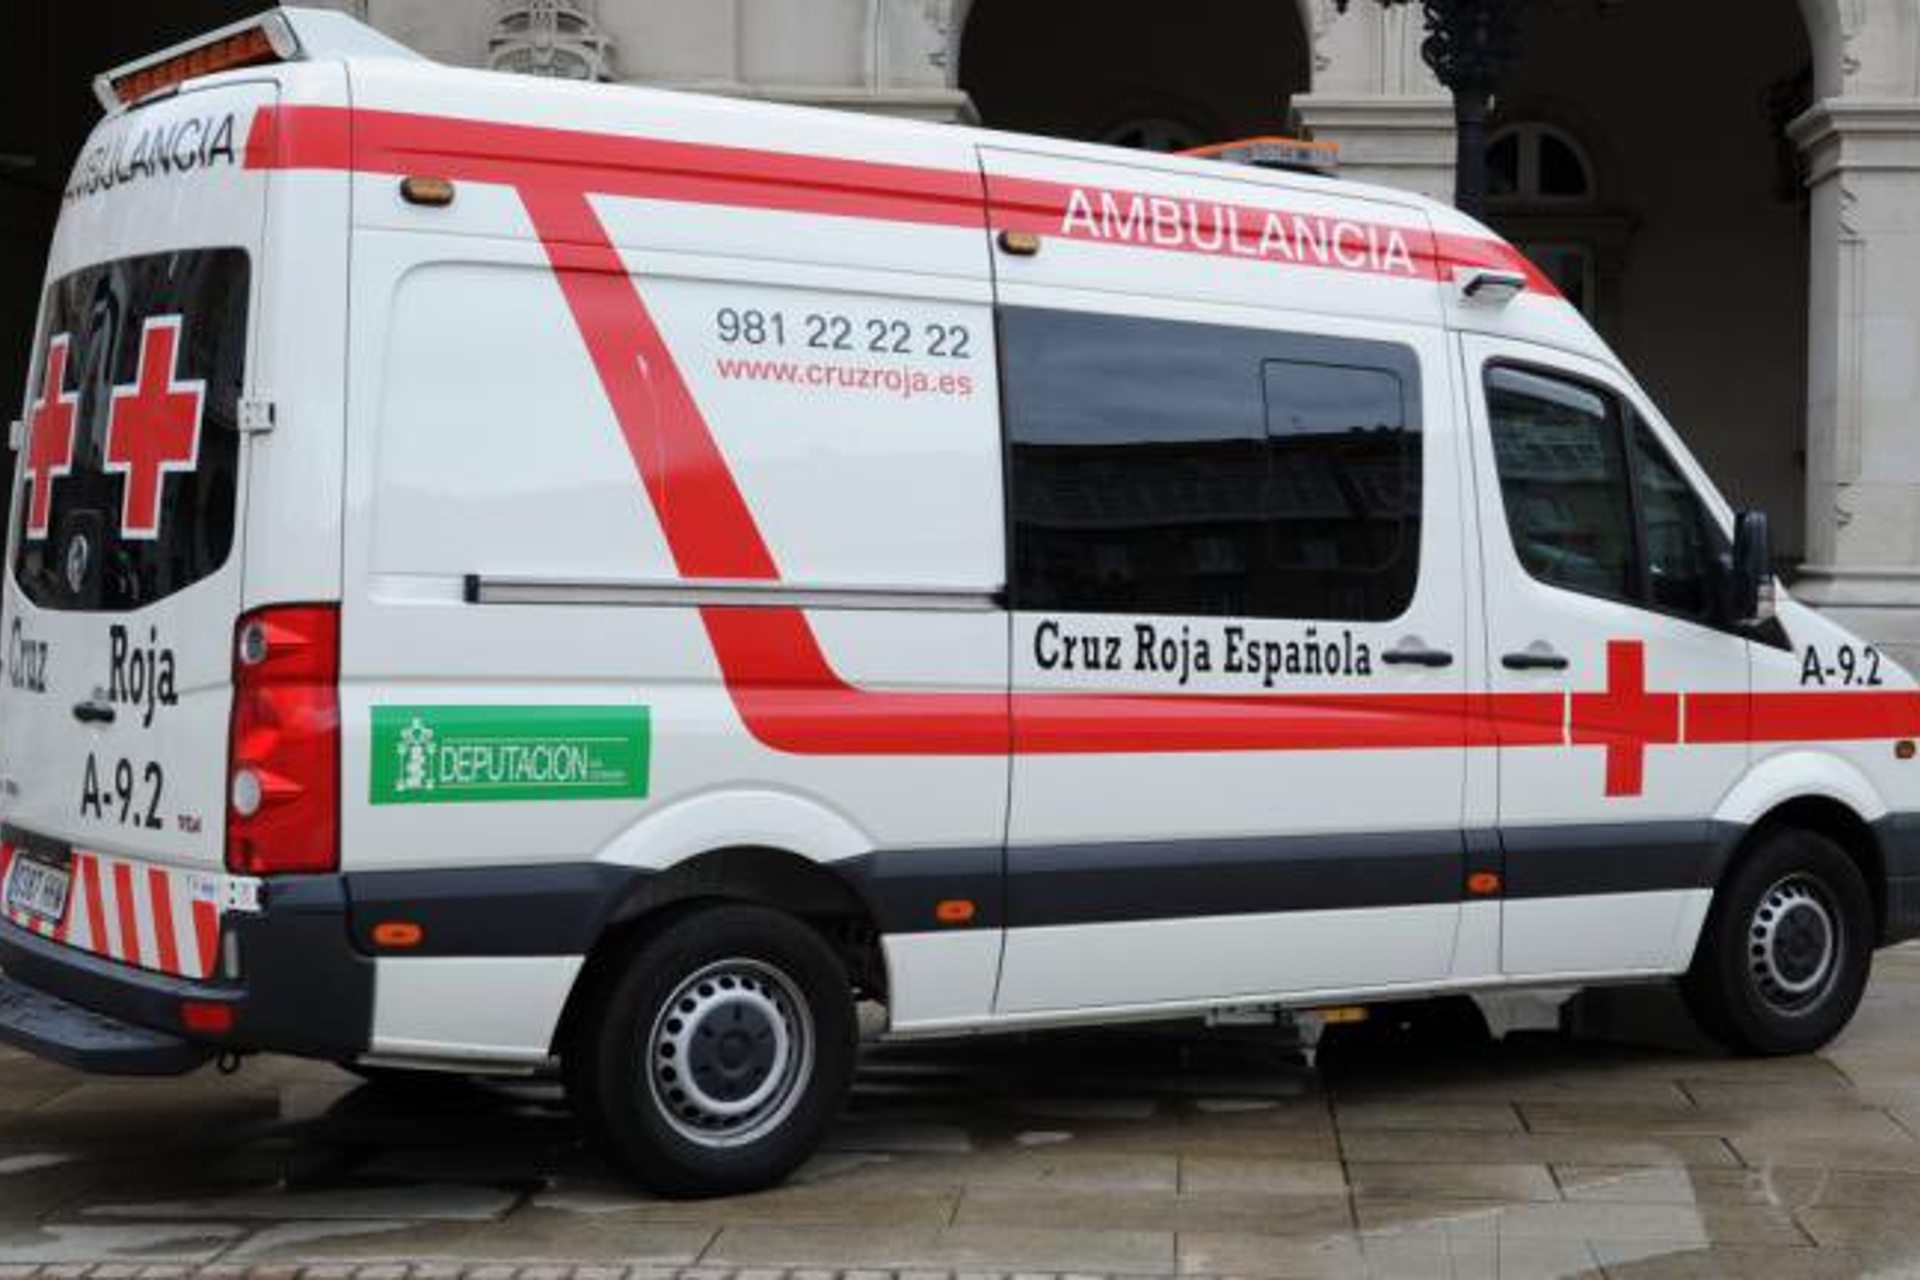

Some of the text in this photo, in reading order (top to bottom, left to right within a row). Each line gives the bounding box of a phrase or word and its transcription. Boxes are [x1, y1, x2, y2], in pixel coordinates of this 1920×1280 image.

[63, 113, 235, 206] BULANCIA
[1061, 189, 1416, 273] AMBULANCIA
[717, 308, 971, 359] 981 22 22 22
[717, 358, 974, 398] www.cruzroja.es
[9, 616, 178, 728] Cruz Roja
[1034, 620, 1372, 687] Cruz Roja Española
[1801, 644, 1883, 686] A-9.2
[81, 752, 163, 831] A-9.2
